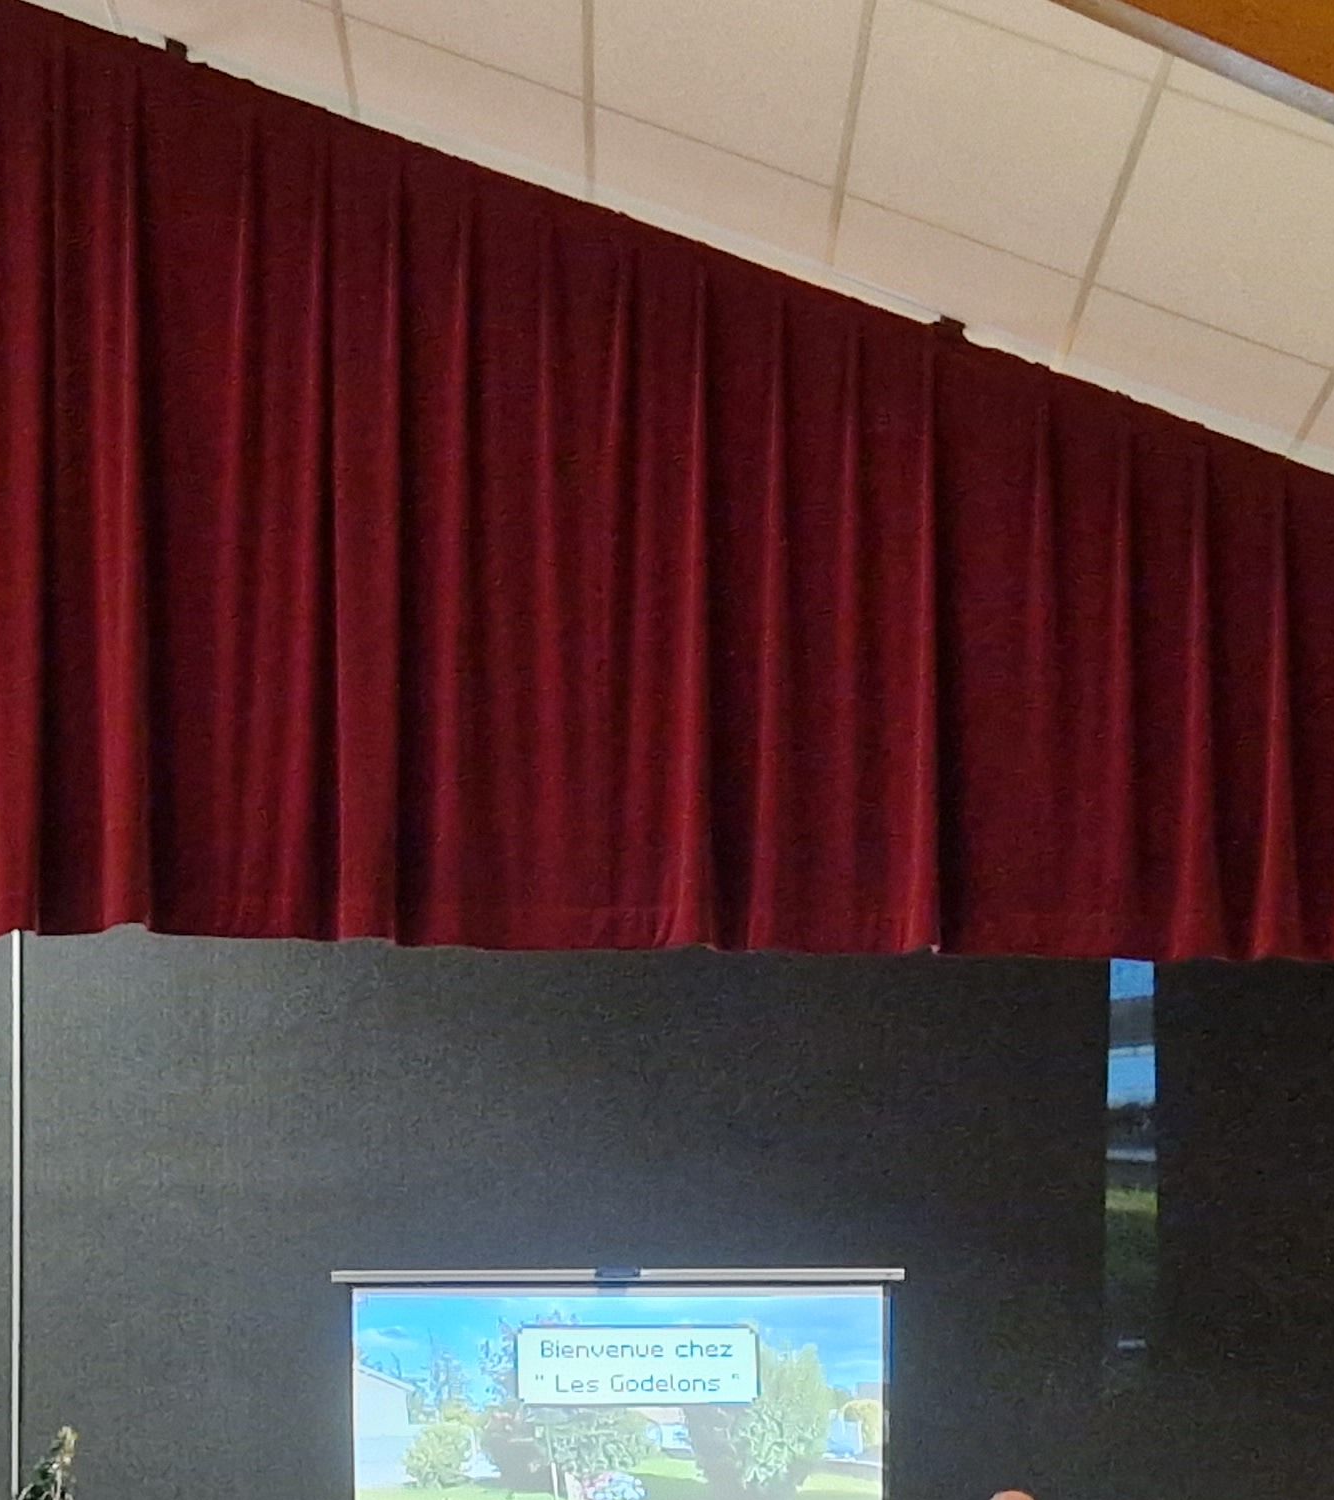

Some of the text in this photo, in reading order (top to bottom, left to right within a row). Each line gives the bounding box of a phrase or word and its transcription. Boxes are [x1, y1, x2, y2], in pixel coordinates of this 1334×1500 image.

[540, 1340, 734, 1358] Bienvenue chez
[555, 1375, 600, 1393] Les
[610, 1374, 721, 1392] Godelons
